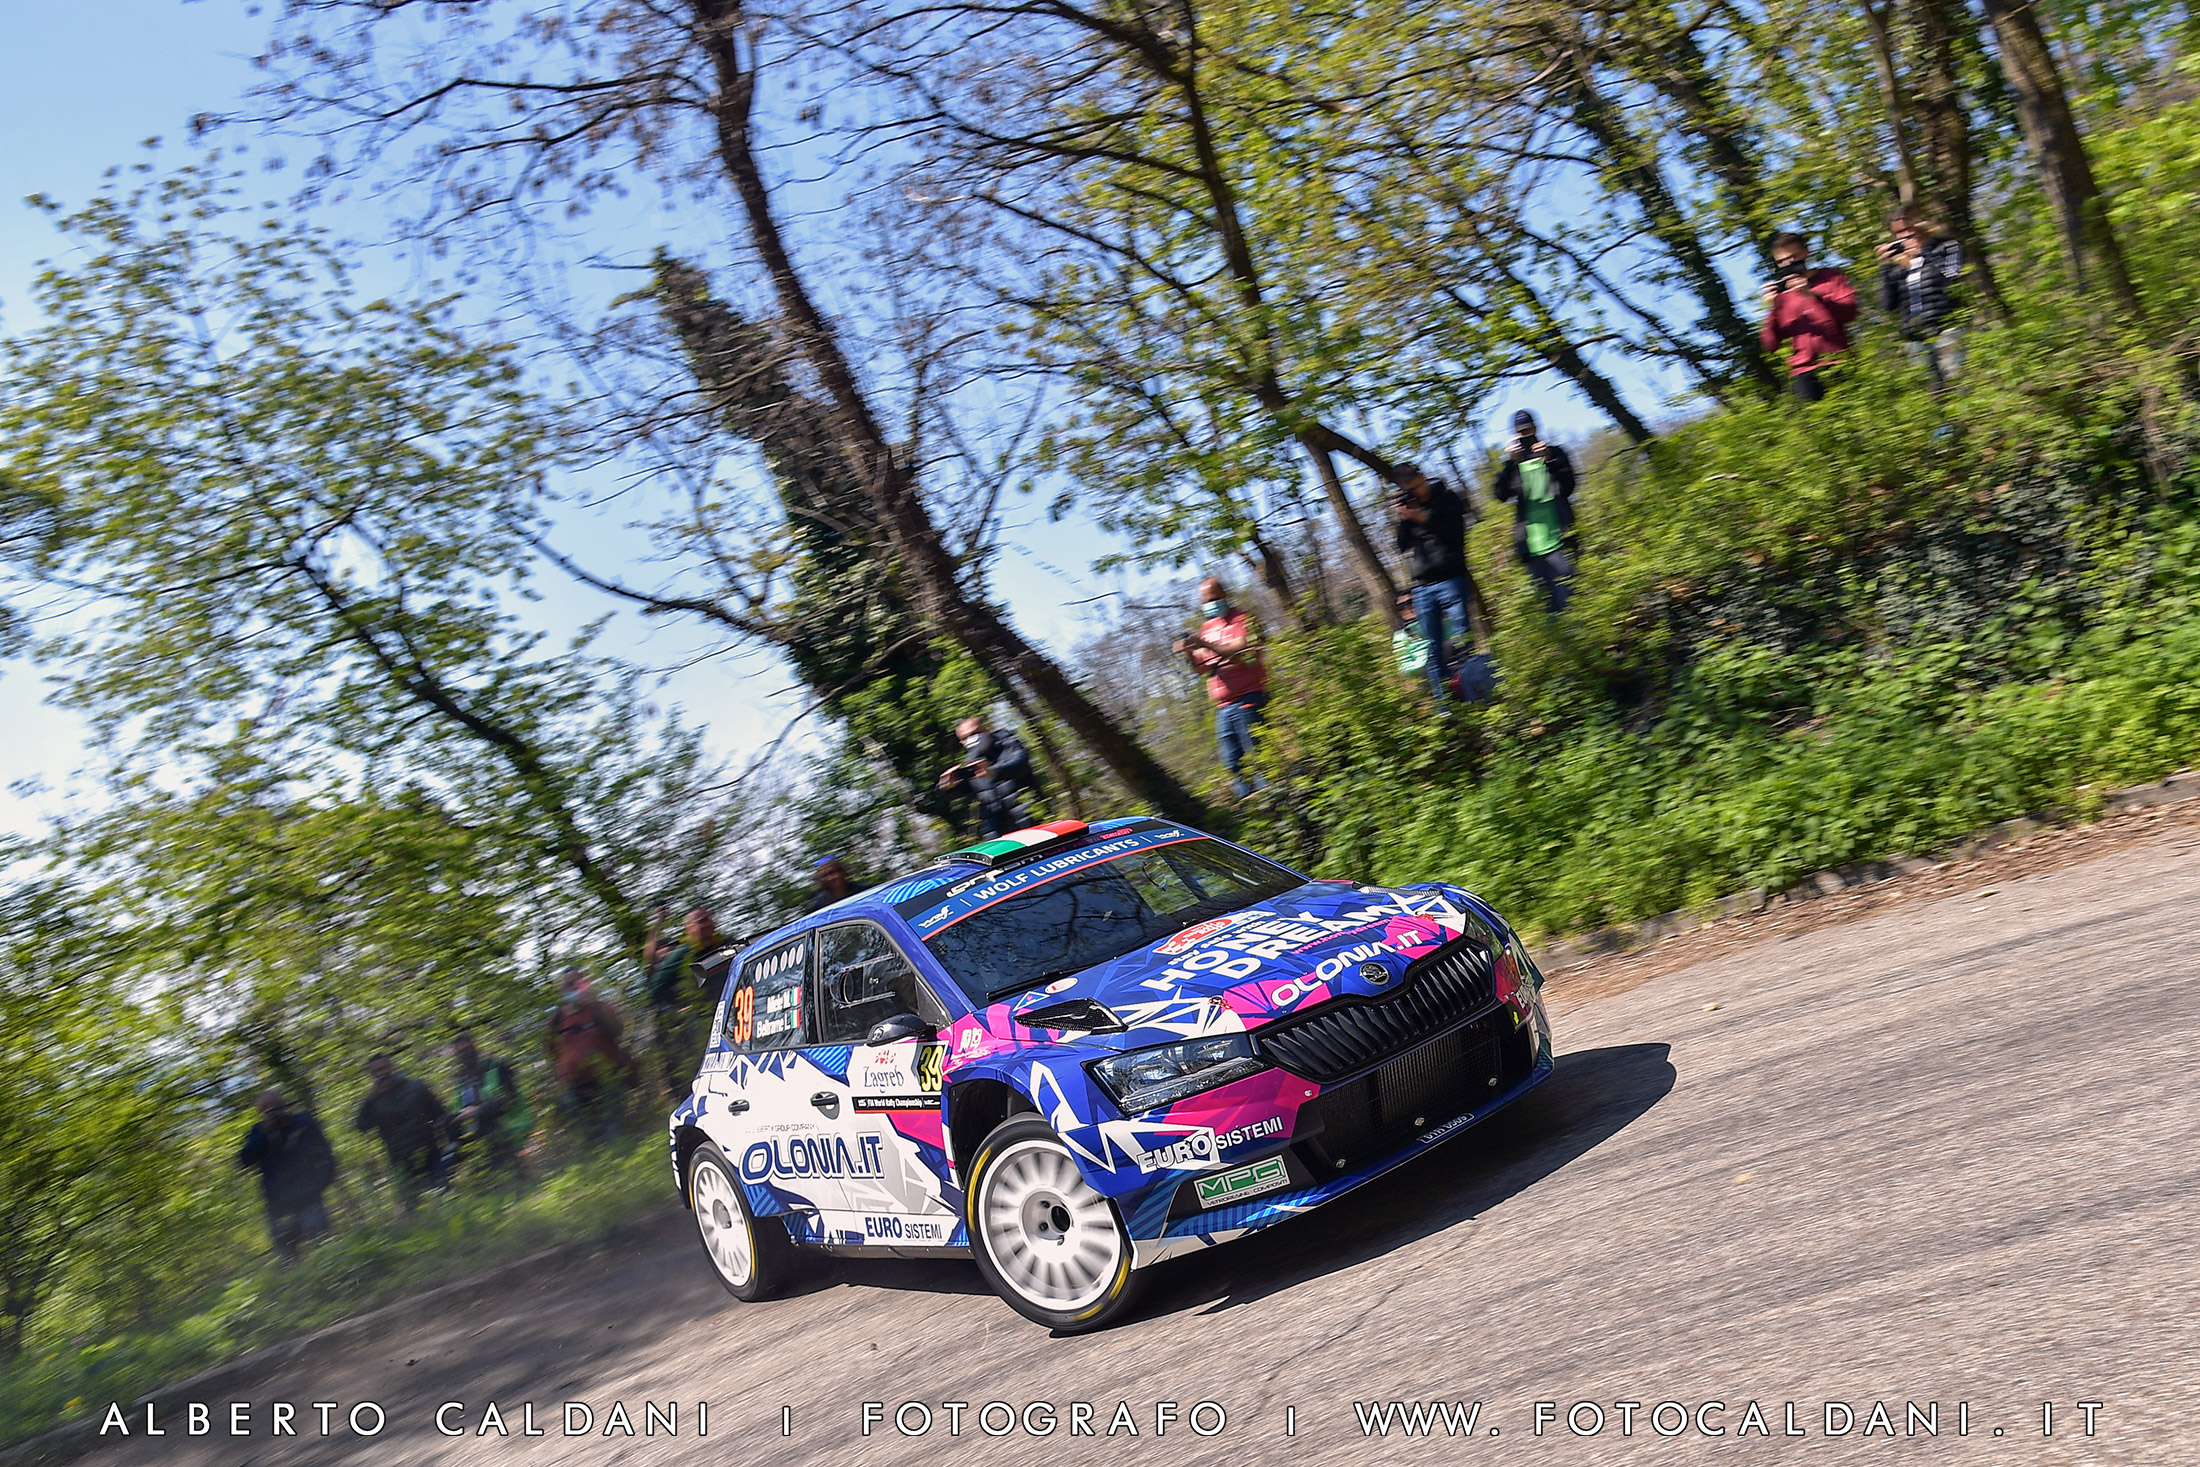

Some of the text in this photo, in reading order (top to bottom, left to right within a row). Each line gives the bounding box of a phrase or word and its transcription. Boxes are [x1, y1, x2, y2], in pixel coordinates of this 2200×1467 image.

[972, 873, 1029, 900] WOLF
[1033, 838, 1141, 879] LUBRICANTS
[1139, 910, 1324, 992] HONEY
[1209, 903, 1403, 980] DREAM
[1271, 930, 1424, 1007] OLONIA.IT
[733, 985, 754, 1044] 39
[863, 1064, 904, 1093] Zagreb
[920, 1045, 944, 1092] 39
[740, 1133, 884, 1184] OLONIA.IT
[1137, 1116, 1284, 1175] EURO SISTEMI
[1200, 1160, 1286, 1197] MPG
[865, 1216, 943, 1240] EURO SISTEMI
